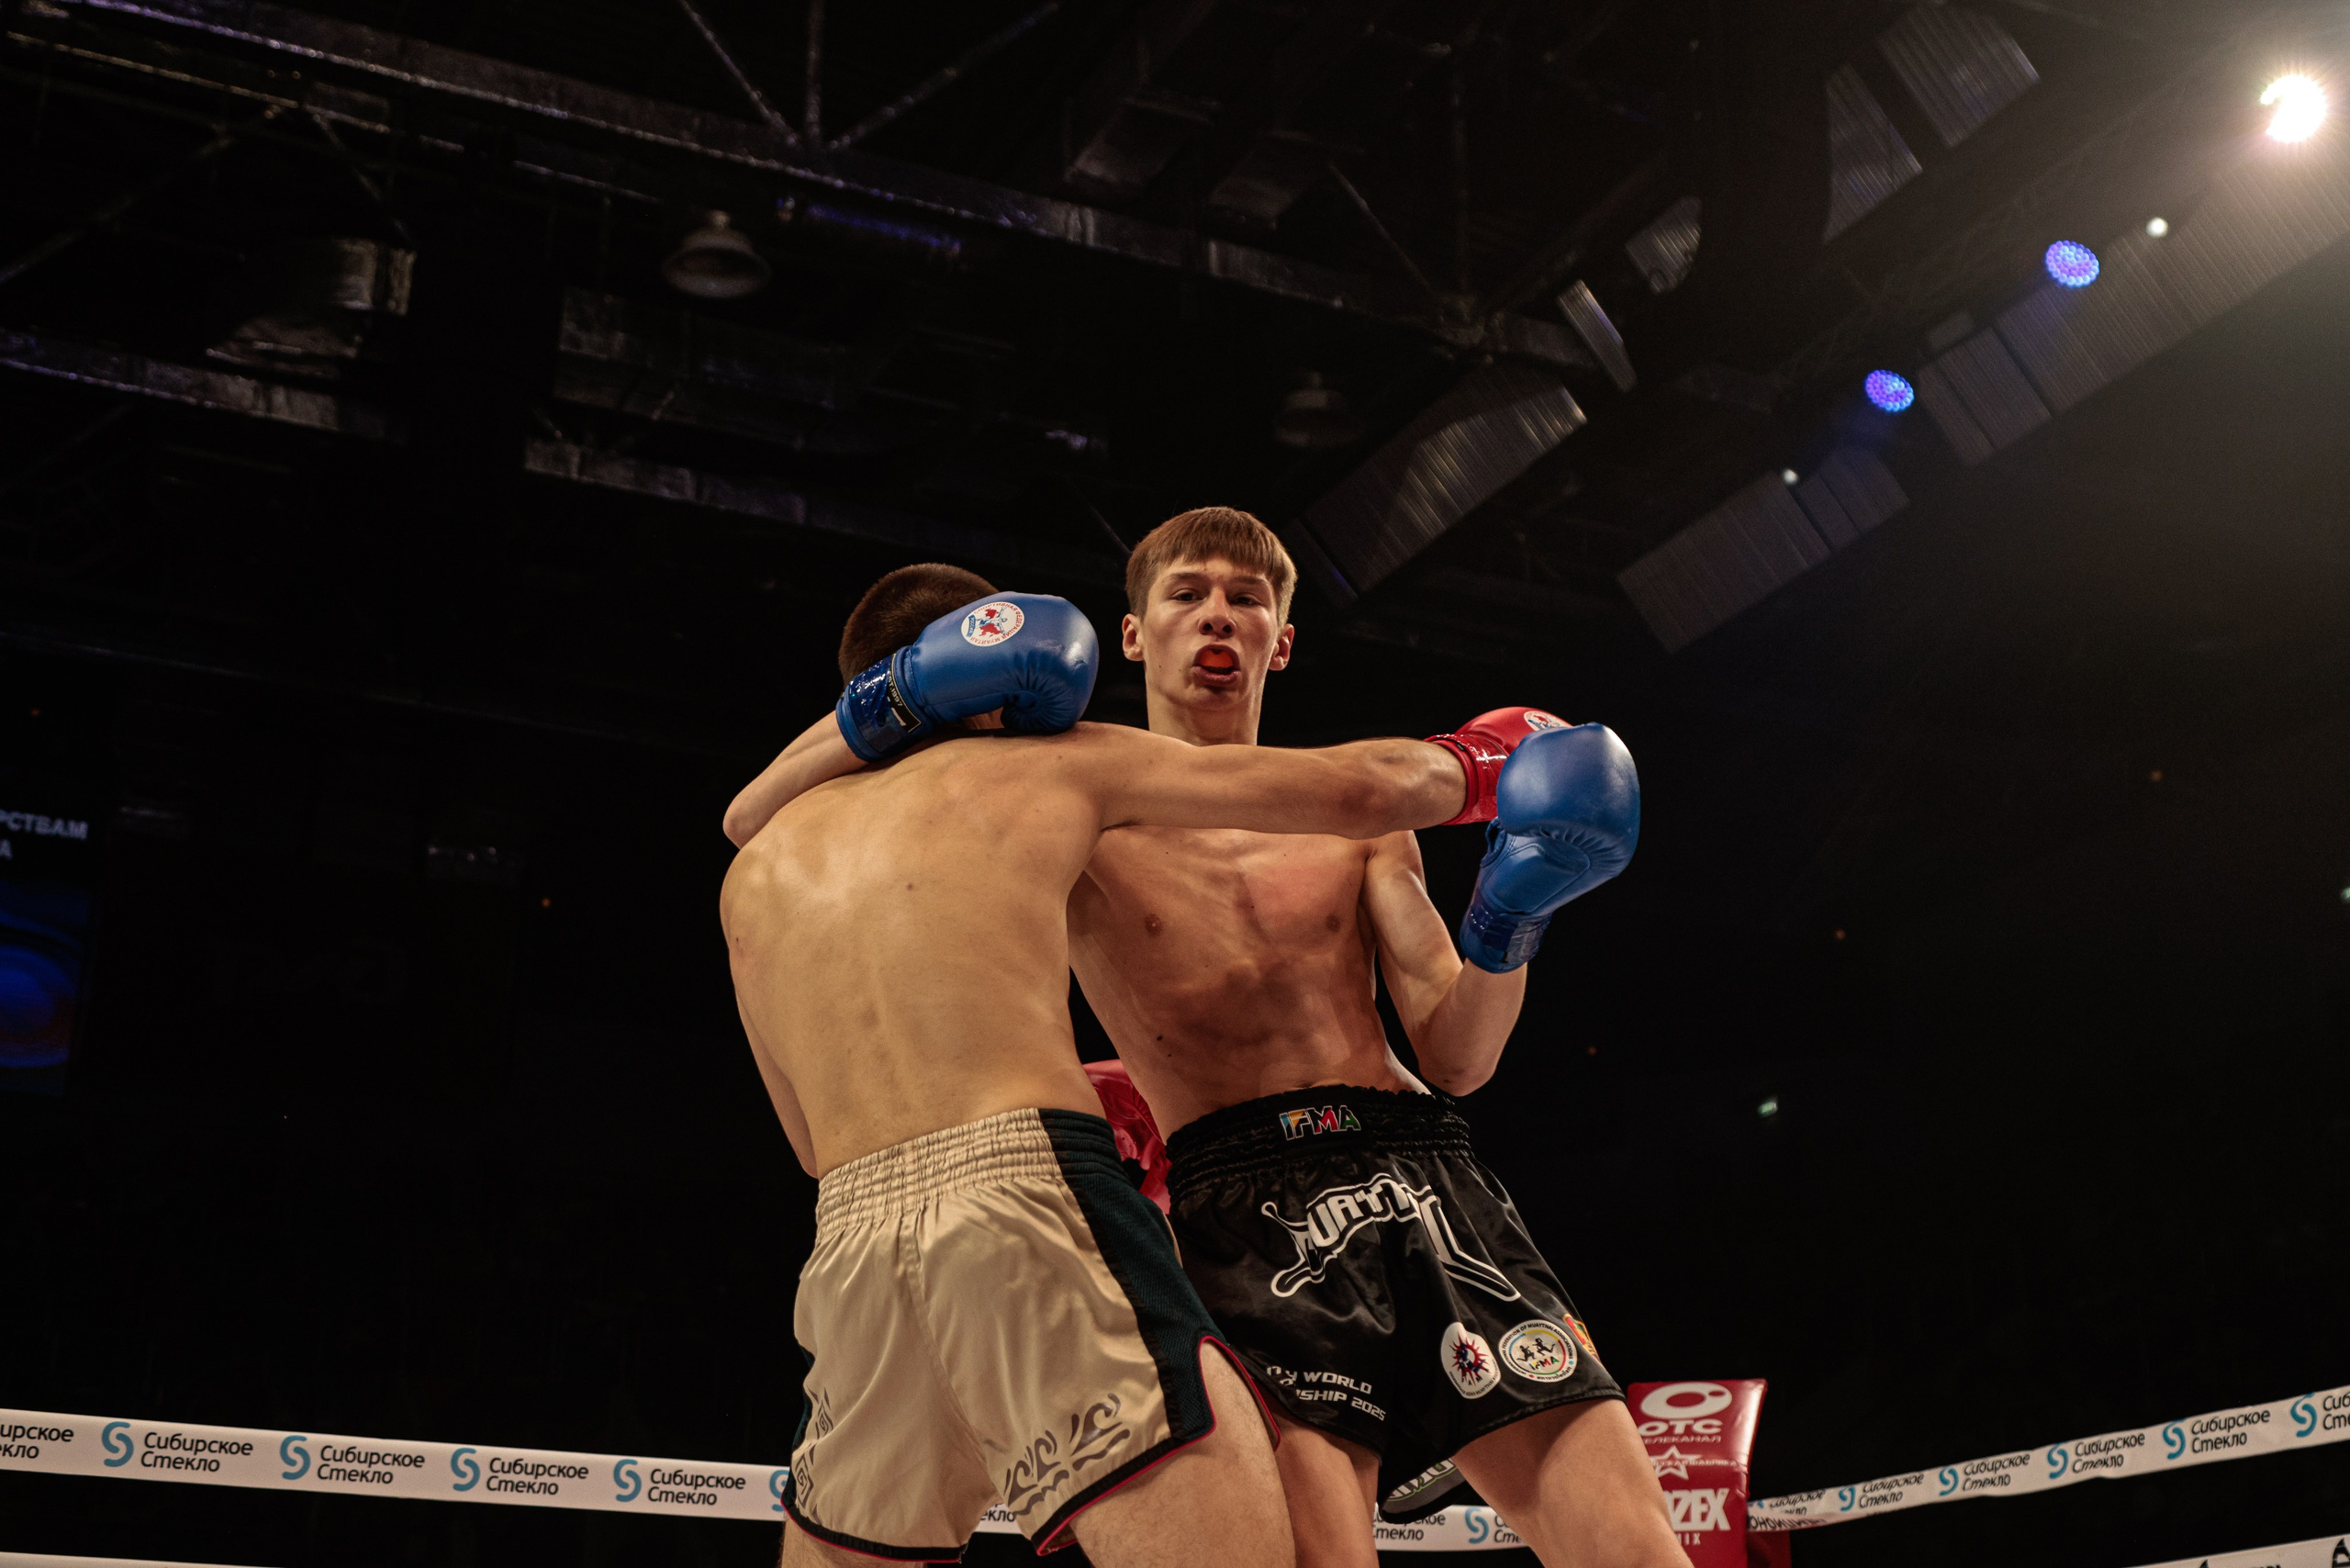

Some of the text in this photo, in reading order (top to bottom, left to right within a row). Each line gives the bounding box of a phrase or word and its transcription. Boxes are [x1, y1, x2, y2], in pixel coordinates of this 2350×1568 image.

[1279, 1104, 1361, 1141] IFMA
[1304, 1371, 1372, 1394] WORLD
[1350, 1396, 1387, 1422] 2025
[2191, 1409, 2271, 1436] Сибирское
[2323, 1414, 2350, 1430] Ст
[144, 1432, 253, 1456] Сибирское
[1642, 1435, 1722, 1445] ЕЛЕКАНАЛ
[2075, 1433, 2145, 1458] Сибирское
[2191, 1431, 2247, 1454] Стекло
[0, 1444, 39, 1459] кло
[140, 1450, 220, 1473] Стекло
[320, 1445, 425, 1468] Сибирское
[317, 1463, 394, 1484] Стекло
[488, 1457, 589, 1481] Сибирское
[1964, 1453, 2031, 1477] Сибирское
[2072, 1453, 2124, 1473] Стекло
[486, 1475, 559, 1495] Стекло
[650, 1469, 746, 1490] Сибирское
[1863, 1473, 1925, 1494] Сибирское
[1962, 1473, 2011, 1492] Стекло
[647, 1486, 718, 1506] Стекло
[1859, 1491, 1903, 1508] Стекло
